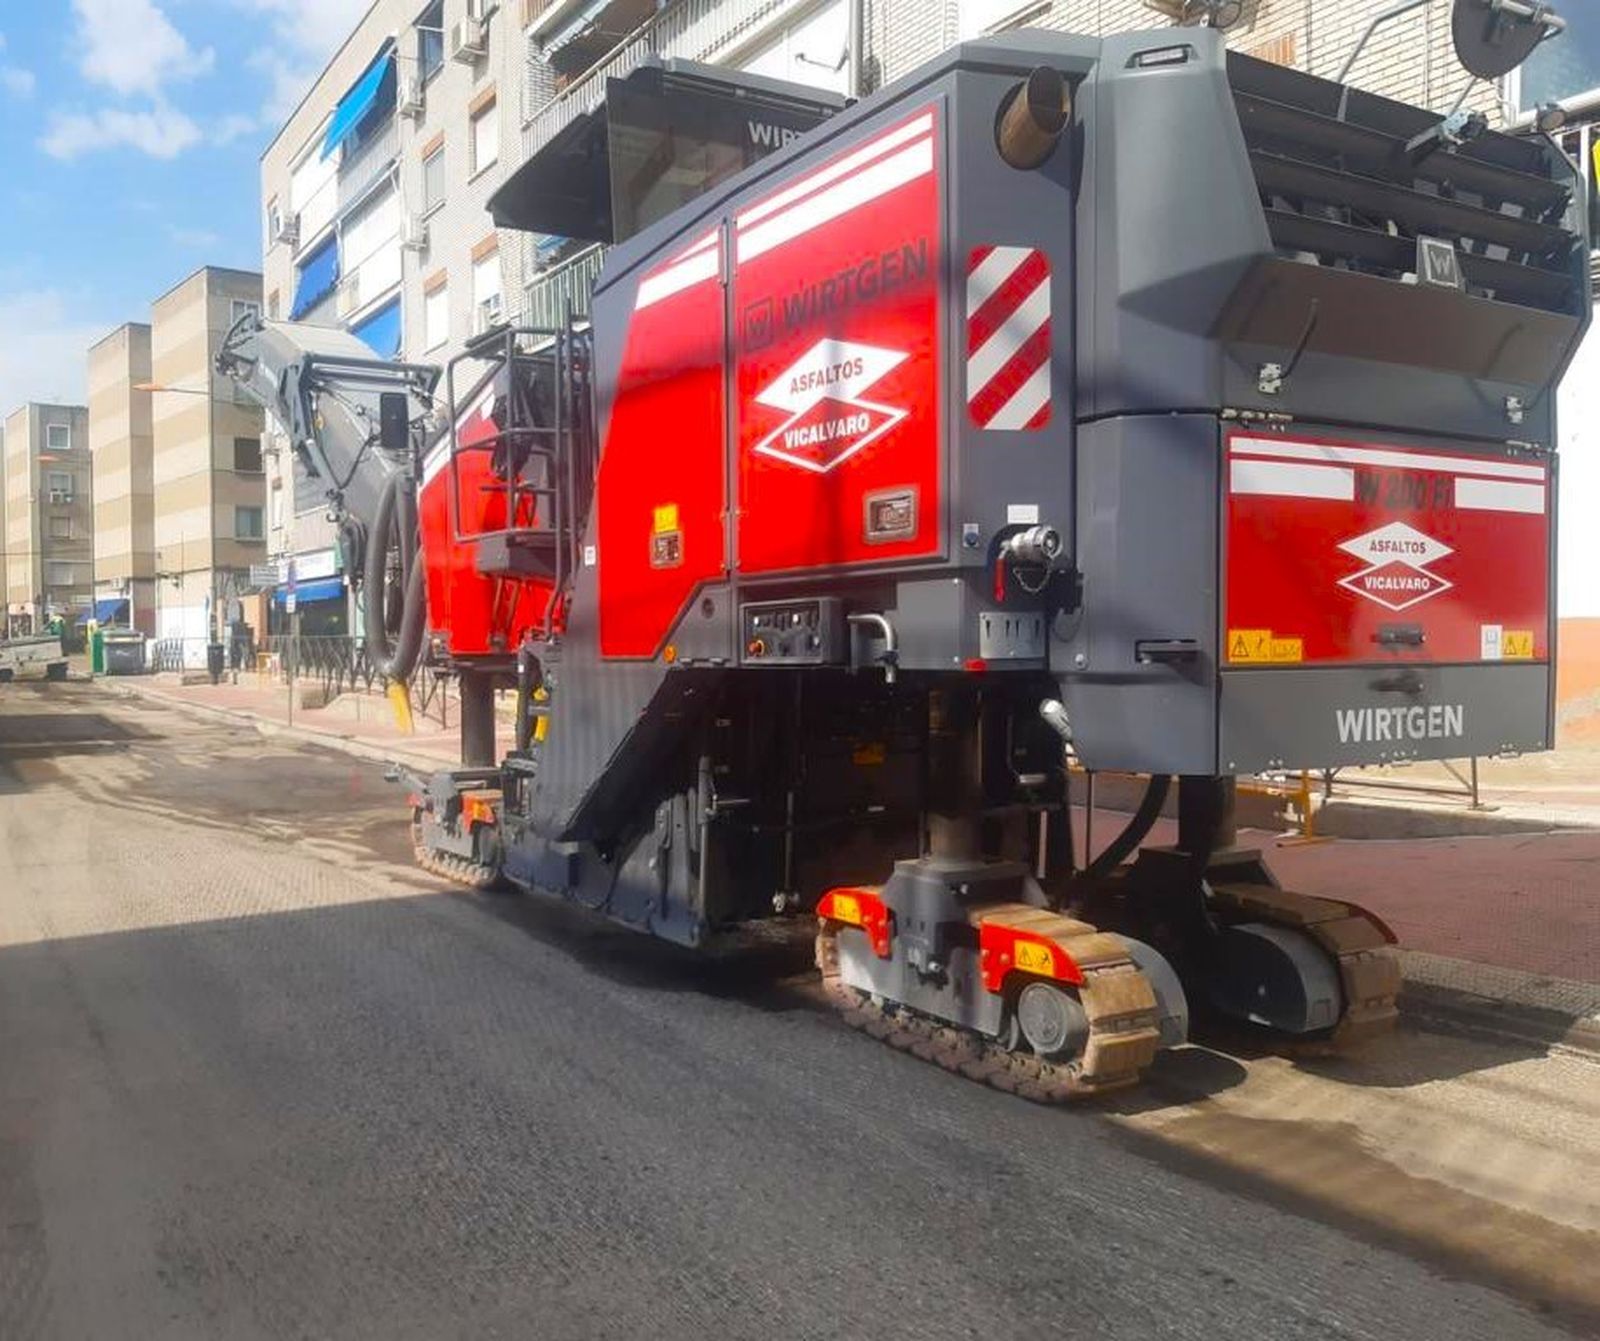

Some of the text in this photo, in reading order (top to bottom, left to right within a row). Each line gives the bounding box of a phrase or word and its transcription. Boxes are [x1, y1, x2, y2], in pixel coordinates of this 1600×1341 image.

[783, 237, 928, 330] WIRTGEN
[789, 357, 864, 396] ASFALTOS
[783, 412, 870, 450] VICALVARO
[1354, 470, 1381, 505] W
[1369, 539, 1427, 555] ASFALTOS
[1363, 575, 1431, 591] VICALVARO
[1335, 703, 1463, 743] WIRTGEN
